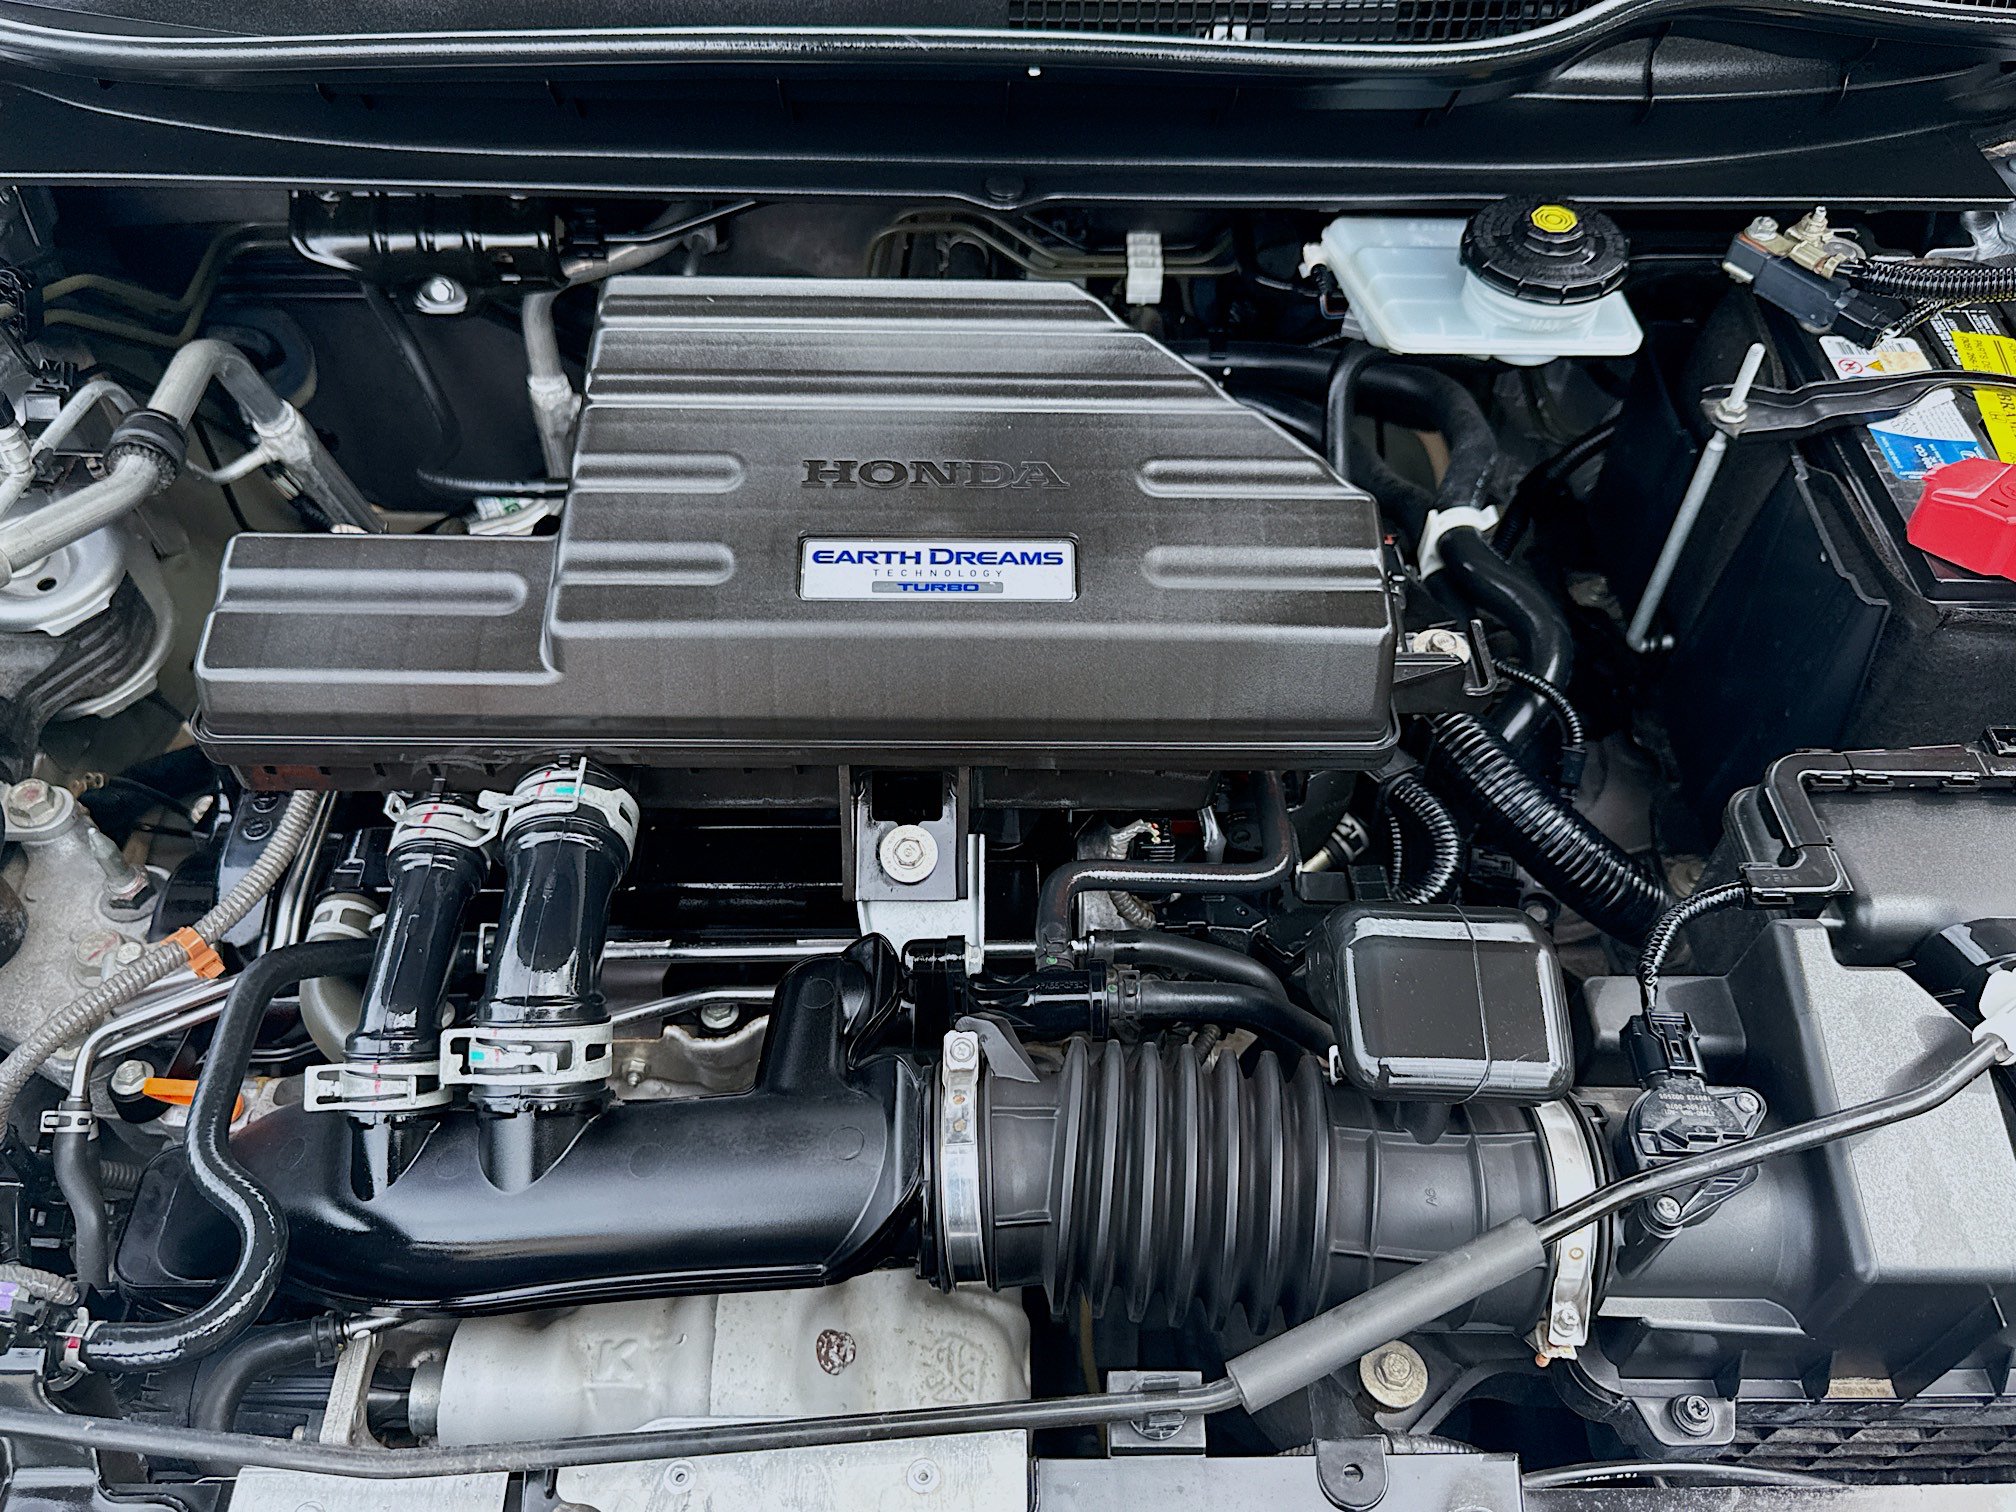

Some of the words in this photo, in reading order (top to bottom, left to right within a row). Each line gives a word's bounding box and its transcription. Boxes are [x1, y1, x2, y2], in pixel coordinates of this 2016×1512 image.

[801, 459, 1071, 488] HONDA
[812, 550, 922, 565] EARTH
[929, 548, 1064, 566] DREAMS
[873, 568, 1003, 578] TECHNOLOGY
[897, 583, 980, 593] TURBO
